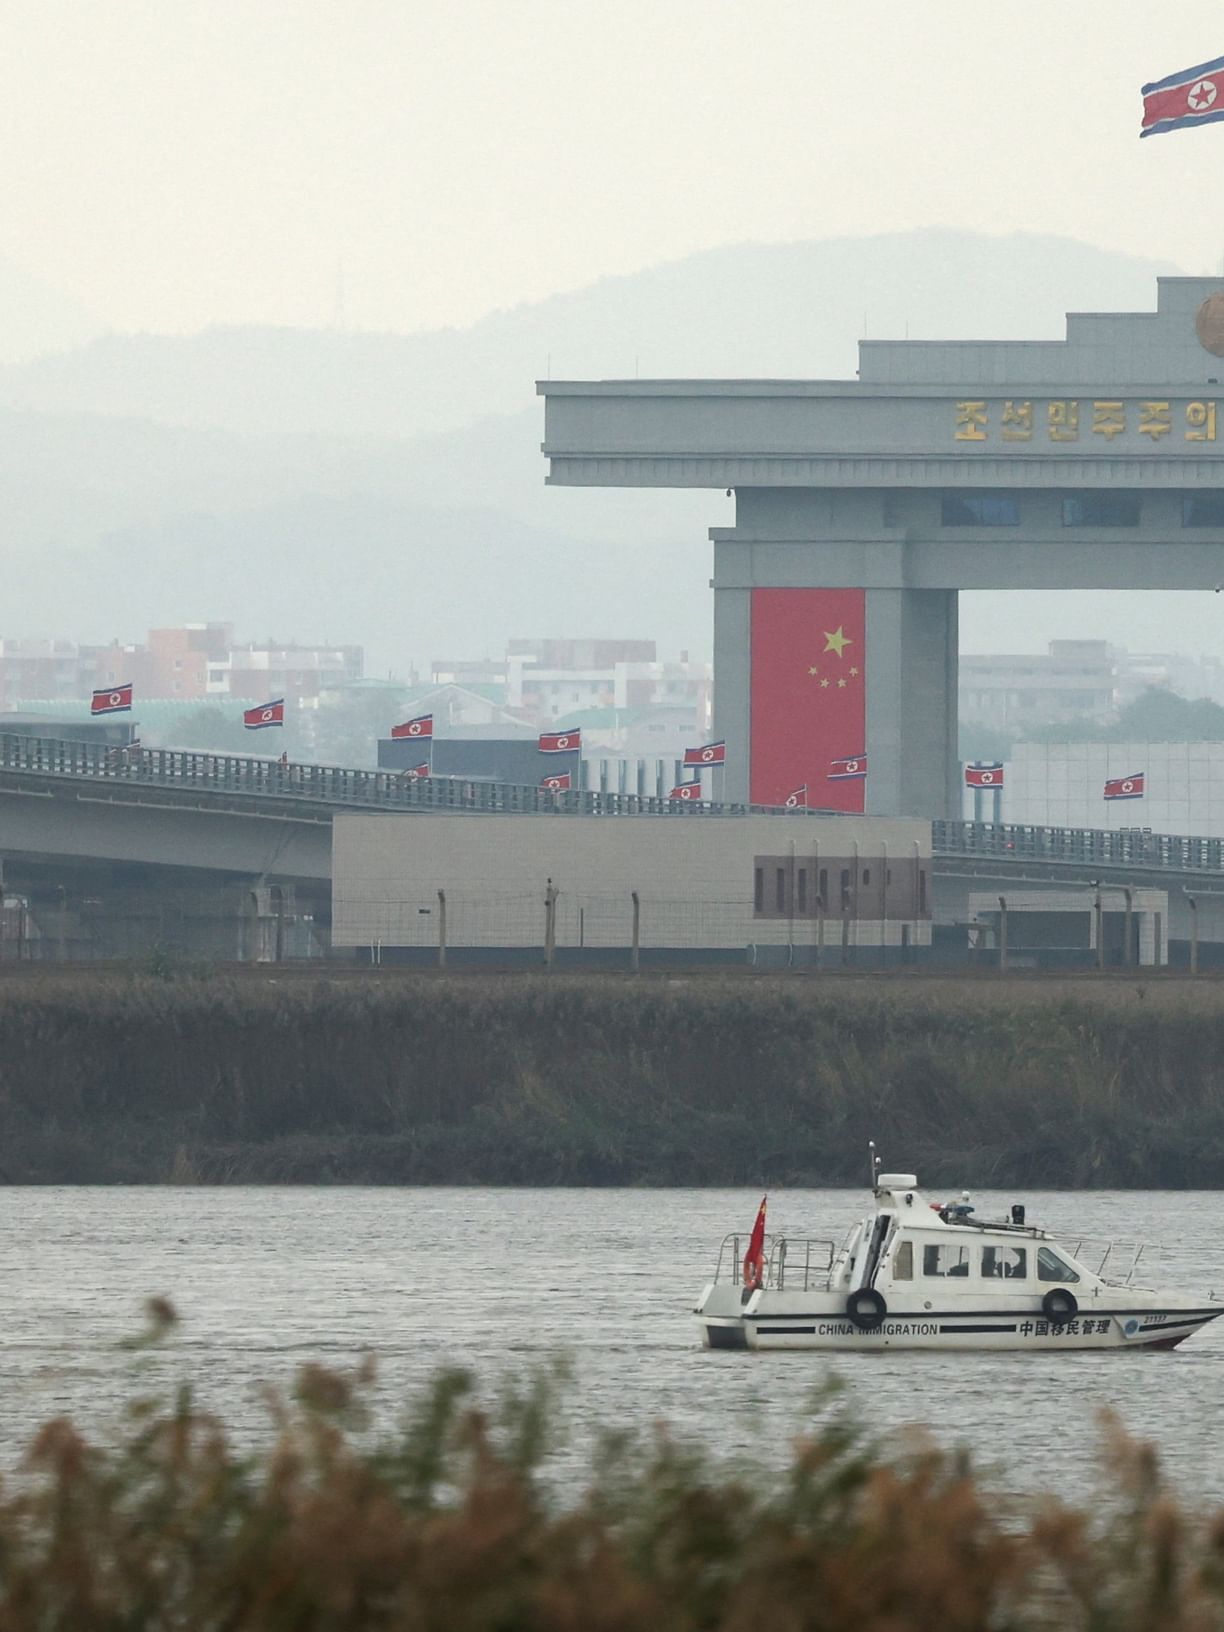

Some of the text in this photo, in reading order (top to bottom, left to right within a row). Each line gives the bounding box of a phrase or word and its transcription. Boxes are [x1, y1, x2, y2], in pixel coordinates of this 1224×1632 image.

[818, 1324, 854, 1335] CHINA
[1020, 1319, 1111, 1337] 中国移民管理
